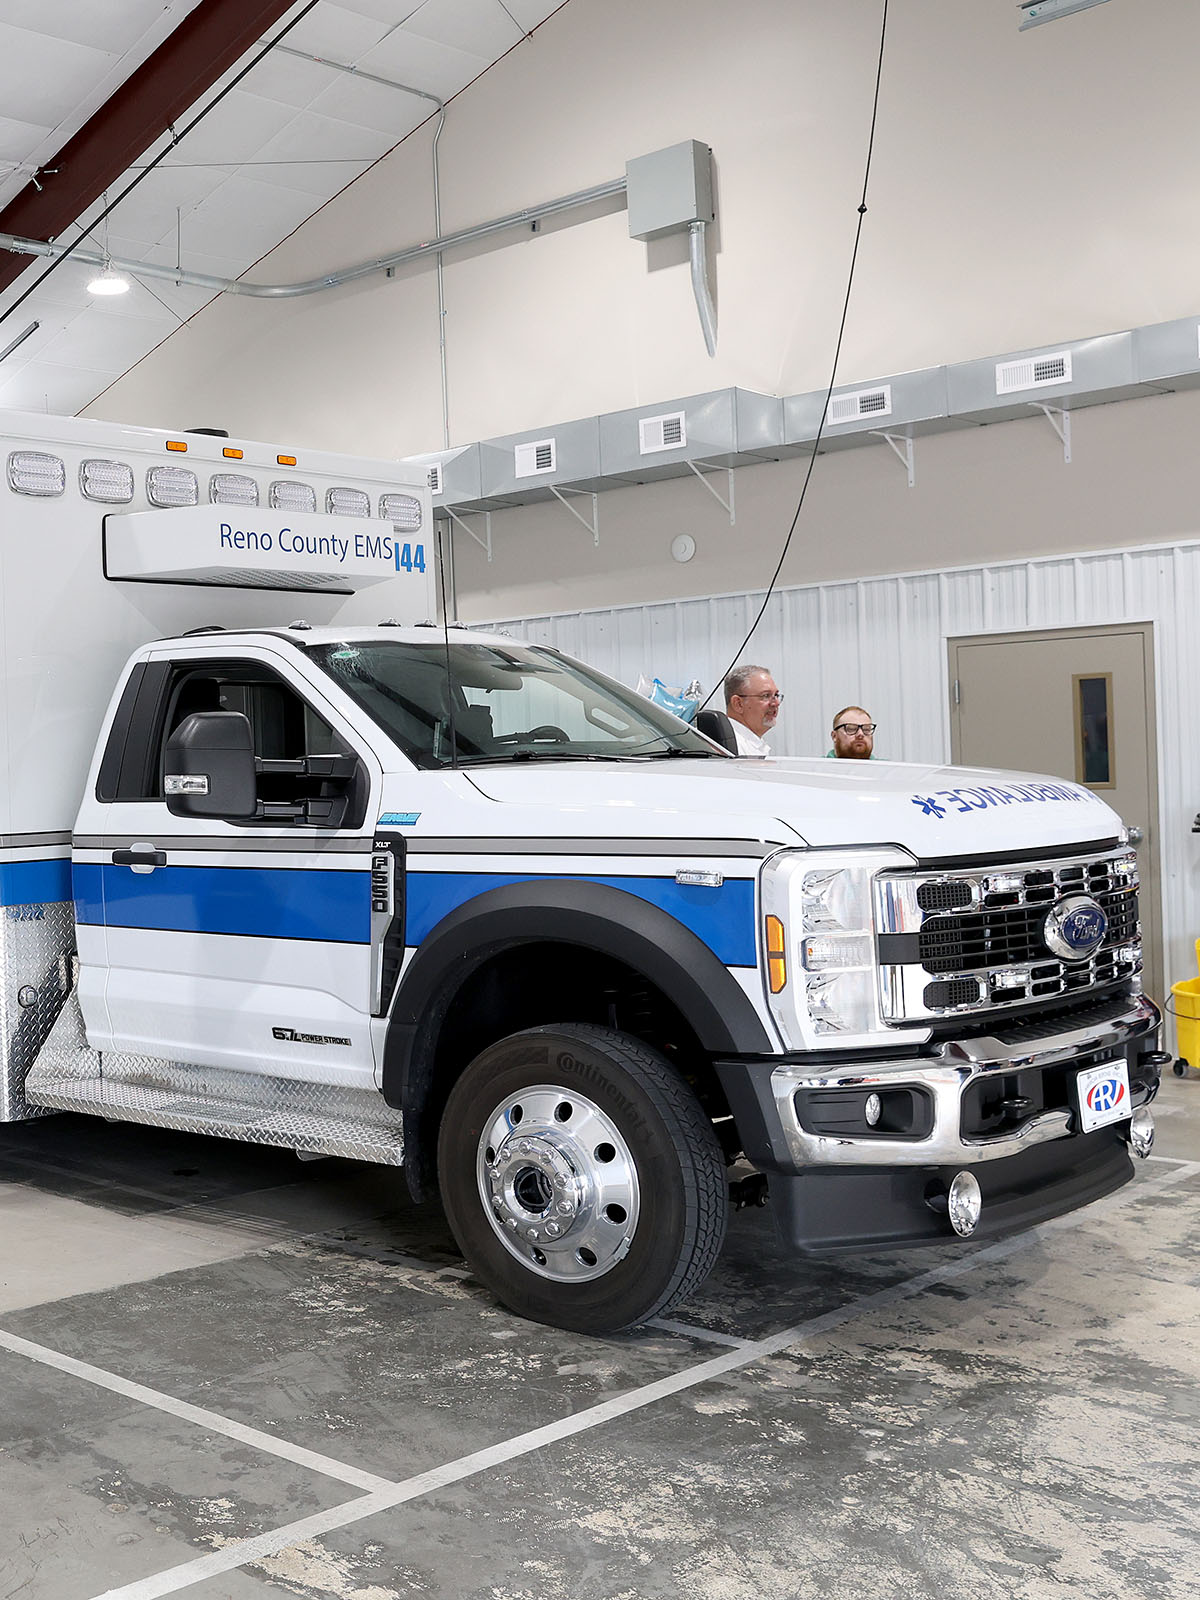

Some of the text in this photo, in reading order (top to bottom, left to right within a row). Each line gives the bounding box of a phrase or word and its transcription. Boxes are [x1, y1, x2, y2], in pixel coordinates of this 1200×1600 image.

[220, 523, 393, 562] Reno County EMS
[1072, 914, 1100, 941] Ford
[300, 1033, 323, 1044] POWER
[323, 1036, 350, 1046] STROKE
